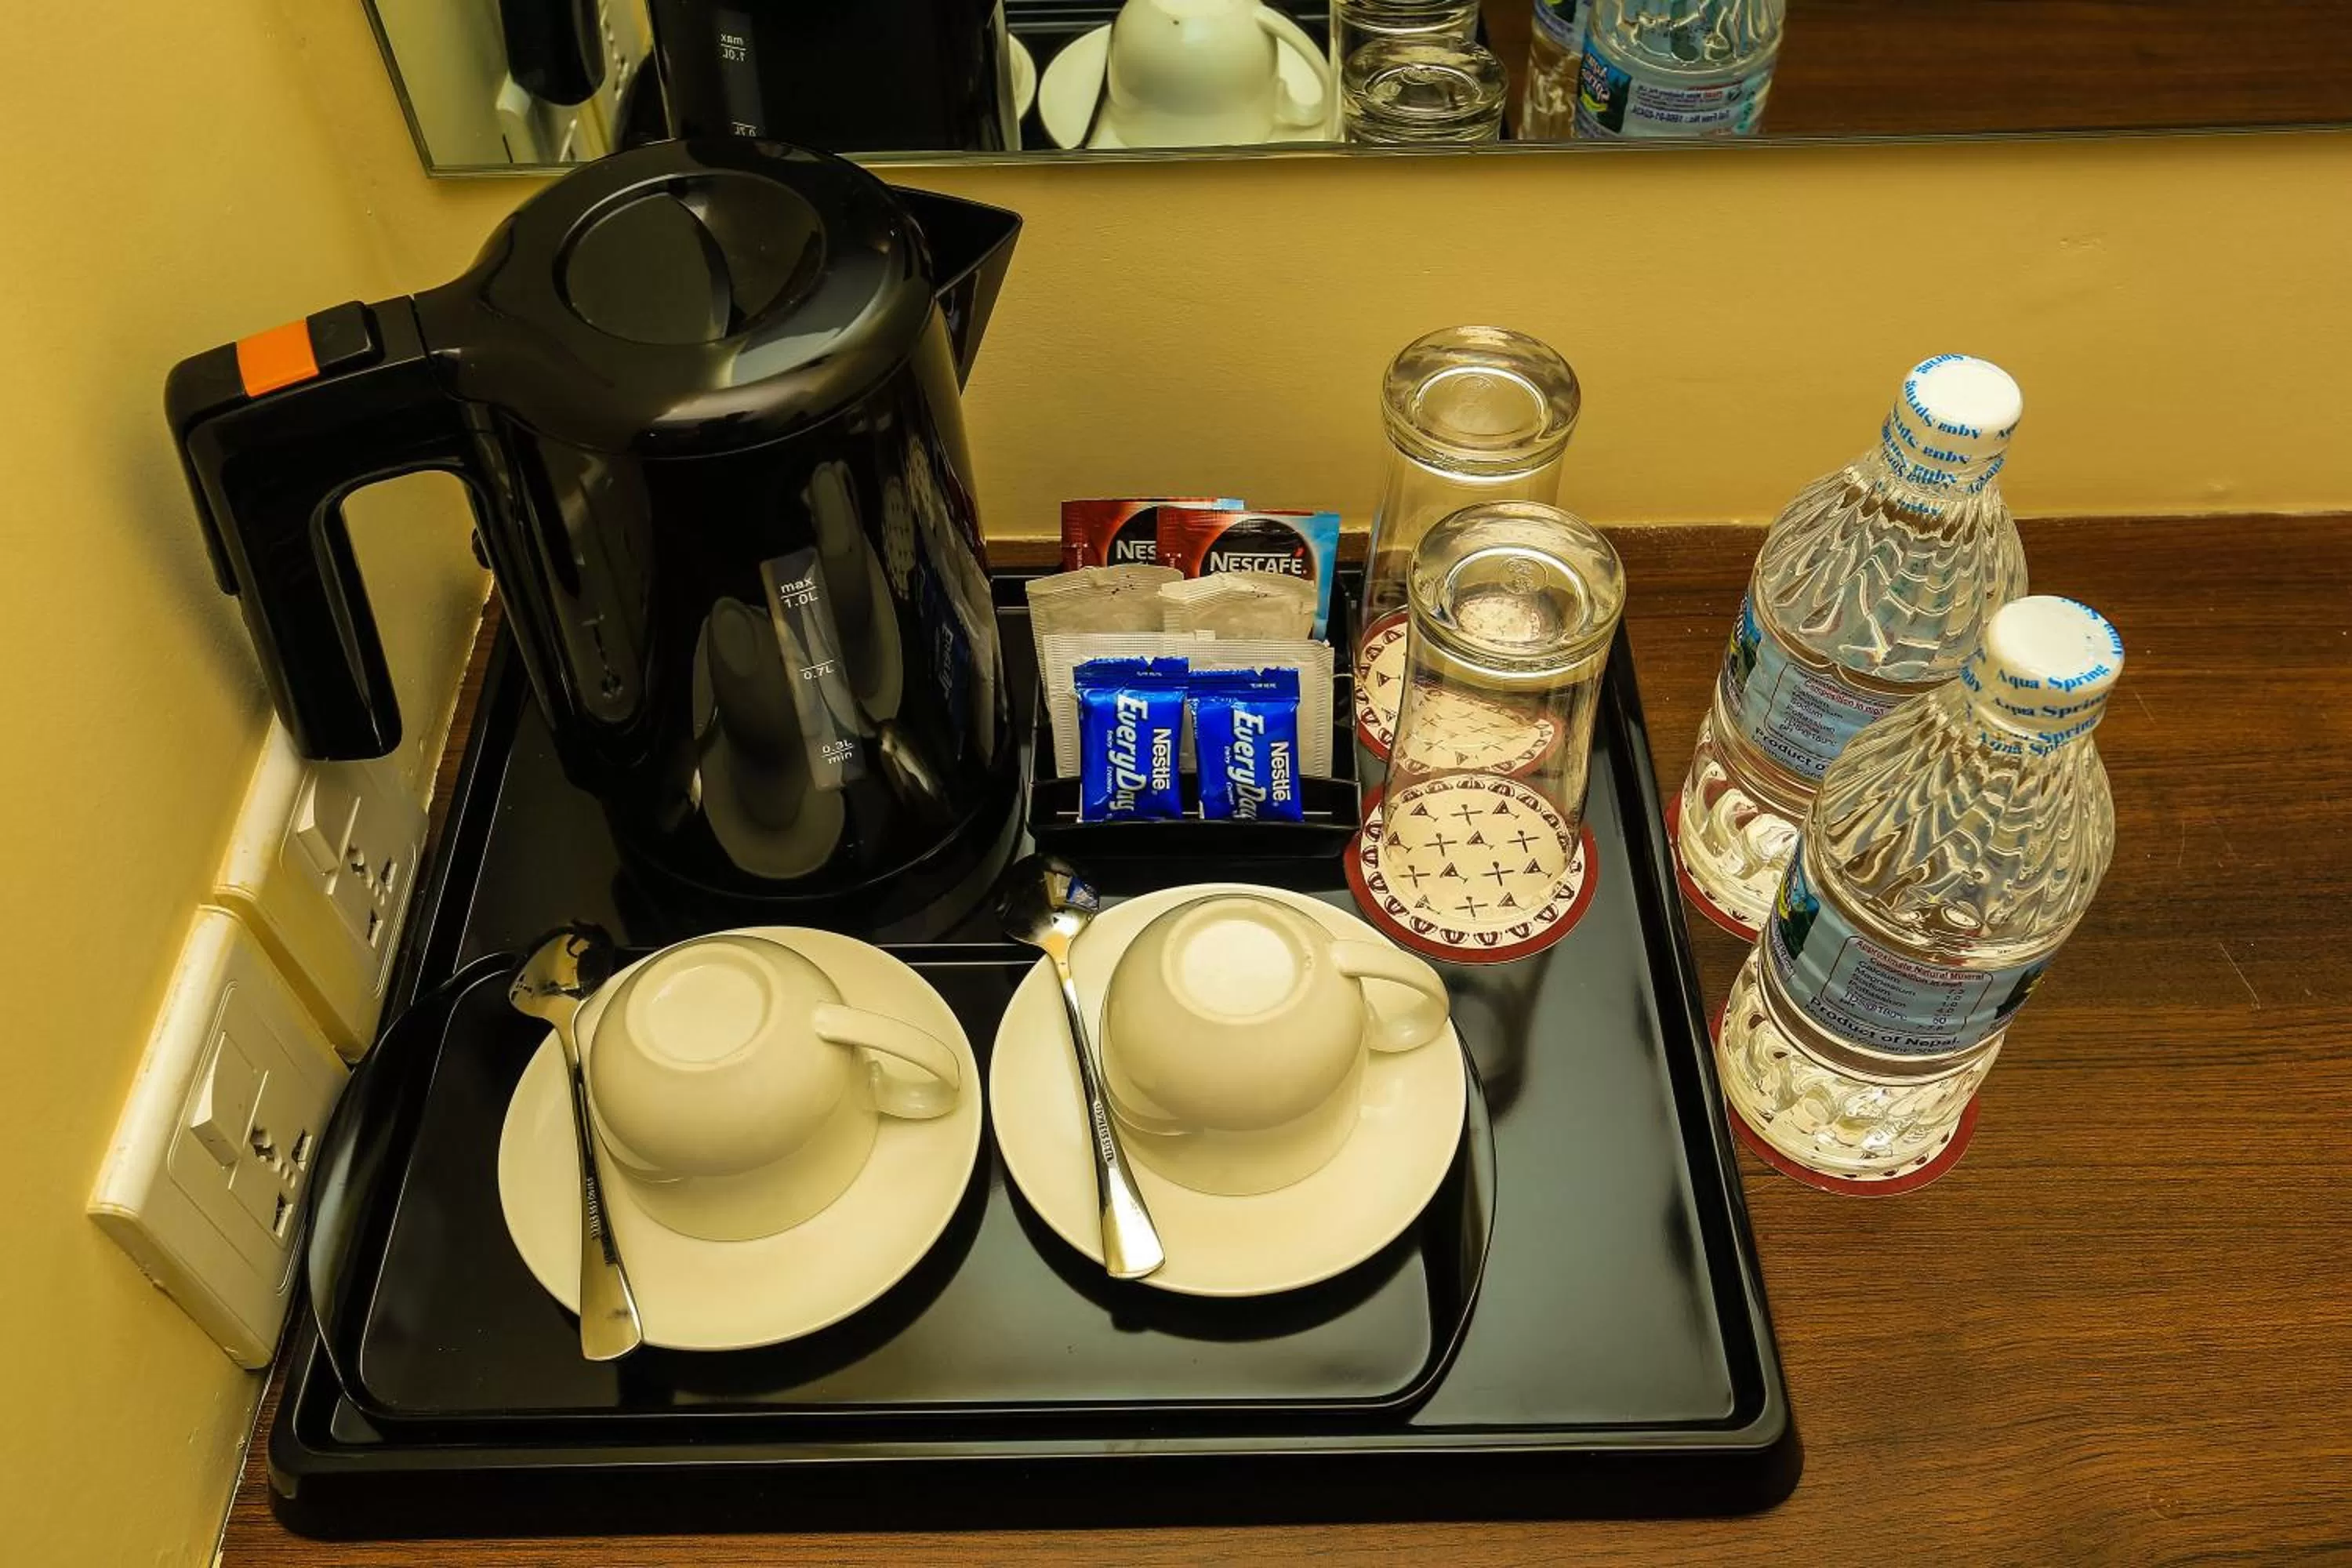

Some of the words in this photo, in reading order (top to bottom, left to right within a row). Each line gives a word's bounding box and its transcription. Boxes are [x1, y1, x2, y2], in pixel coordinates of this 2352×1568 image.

[781, 576, 814, 593] max
[785, 591, 818, 608] 1.0L
[803, 666, 834, 681] 0.7L
[1997, 669, 2040, 689] Aqua
[2047, 664, 2111, 692] Spring
[1755, 727, 1813, 766] Product
[1809, 995, 1876, 1039] Product
[1882, 1035, 1900, 1044] of
